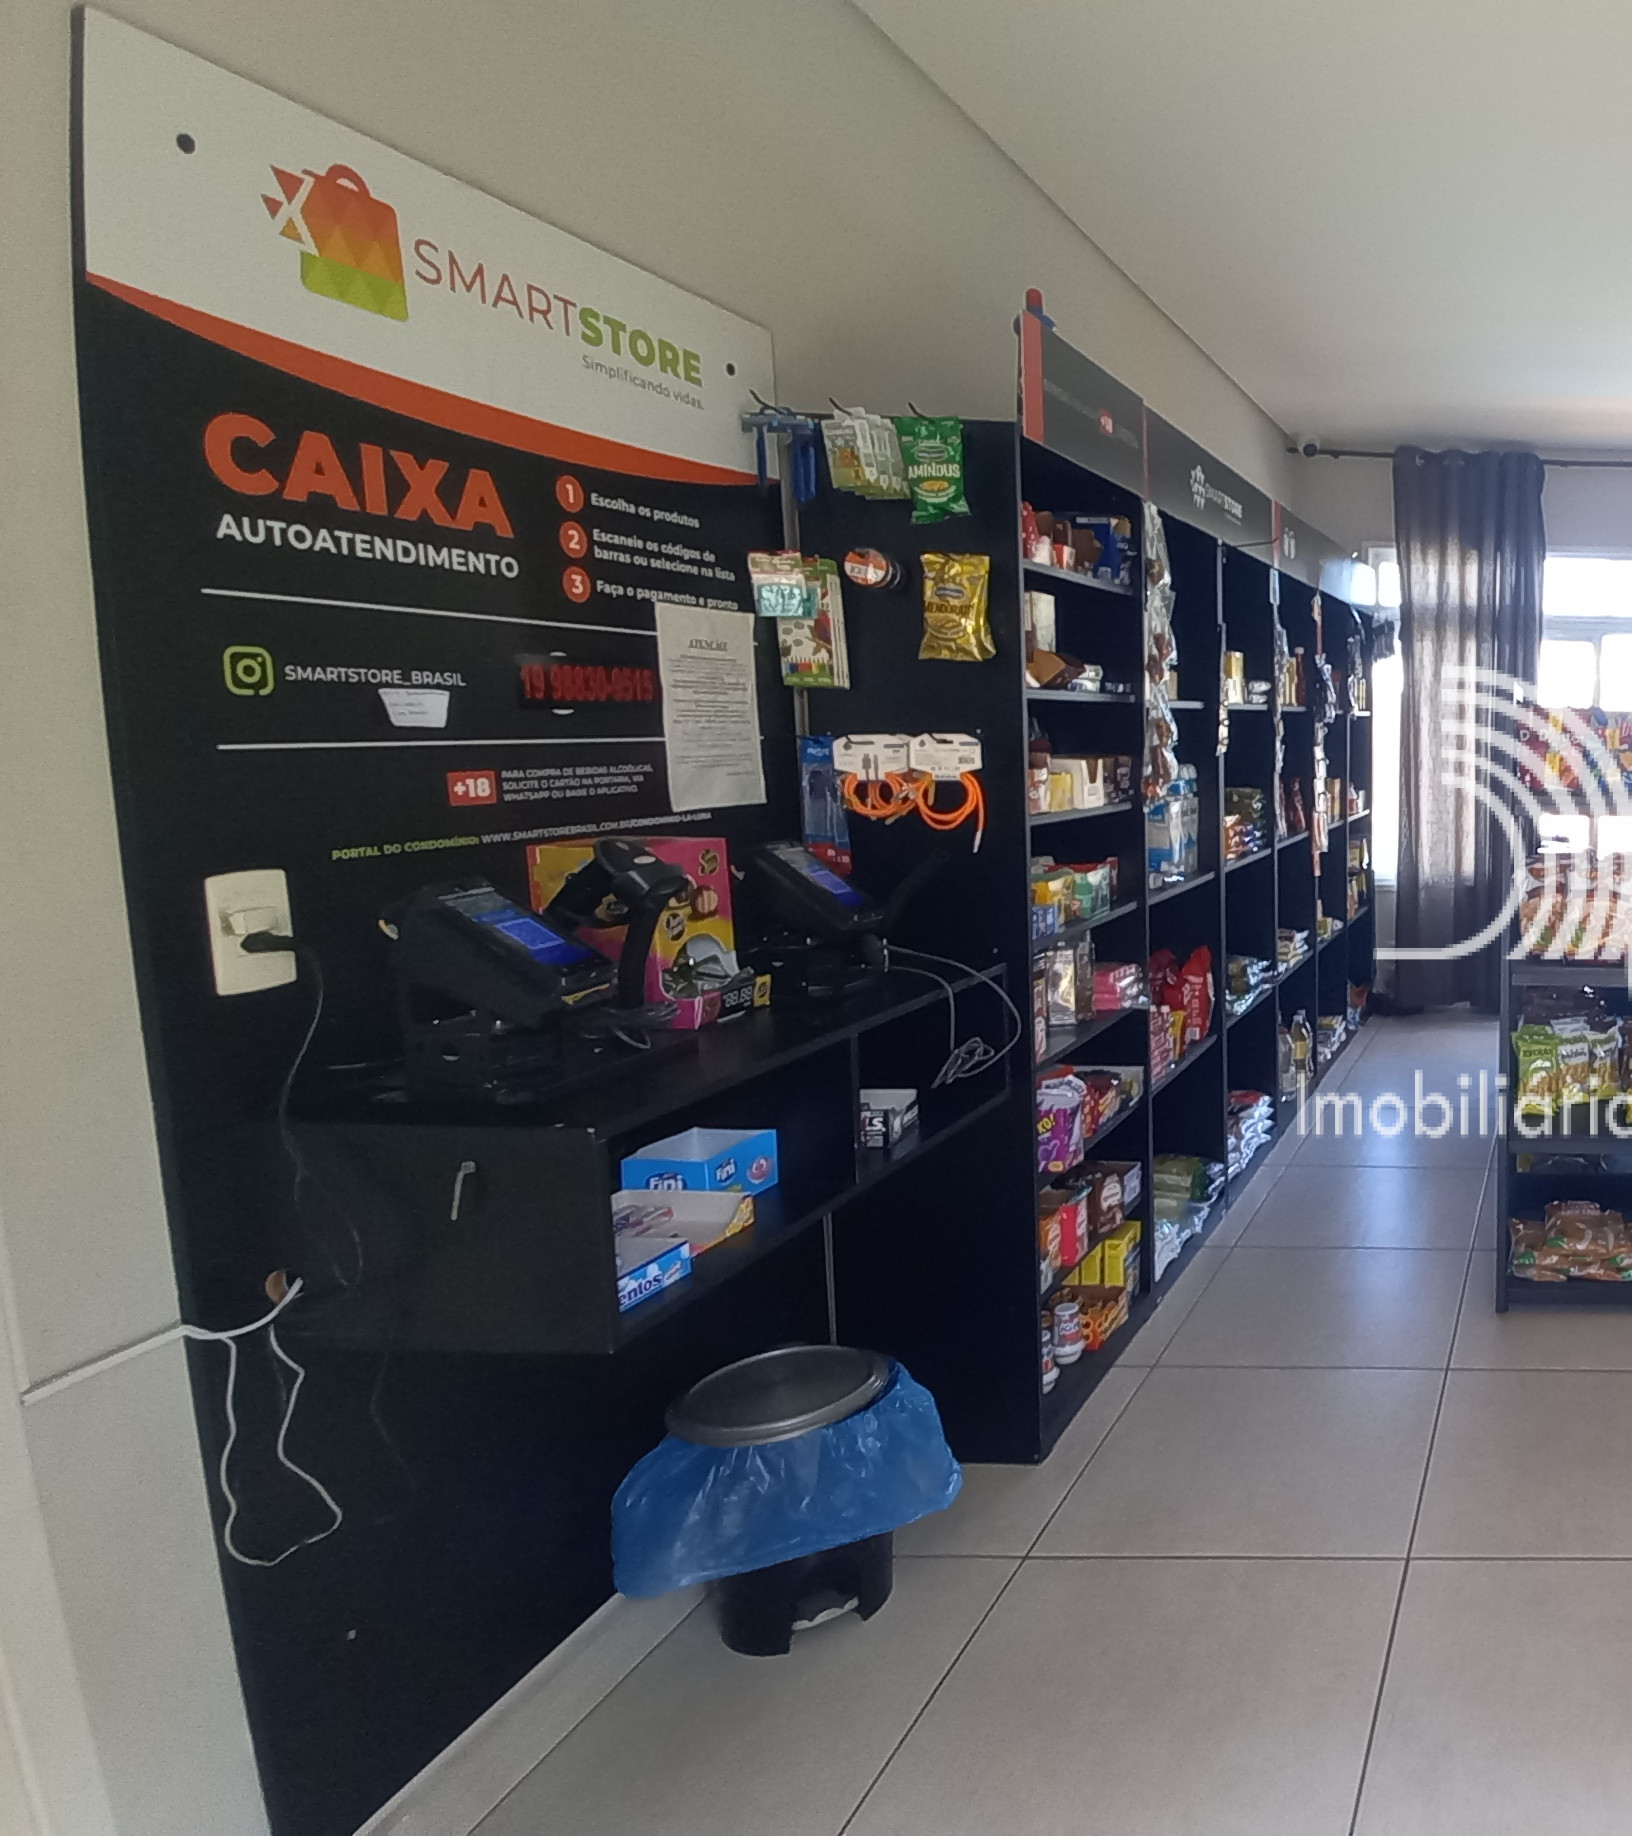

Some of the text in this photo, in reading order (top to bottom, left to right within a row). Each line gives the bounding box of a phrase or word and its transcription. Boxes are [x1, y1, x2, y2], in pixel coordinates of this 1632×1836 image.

[413, 238, 703, 387] SMARTSTORE
[582, 354, 671, 398] Simplificando
[204, 411, 515, 539] CAIXA
[565, 483, 700, 529] 1 Escolha os produtos
[216, 513, 520, 579] AUTOATENDIMENTO
[567, 528, 717, 563] 2 Escaneie os códigos de
[593, 545, 736, 582] barras ou selecione na lista
[570, 574, 584, 595] 3
[596, 579, 624, 599] Faça
[626, 586, 635, 597] o
[636, 587, 697, 605] pagamento
[284, 664, 468, 687] SMARTSTORE_BRASIL
[453, 777, 491, 798] +18
[502, 779, 540, 790] SOLICITE
[331, 845, 382, 861] PORTAL
[383, 843, 402, 855] DO
[716, 1158, 735, 1182] Fini
[619, 1272, 662, 1306] entos
